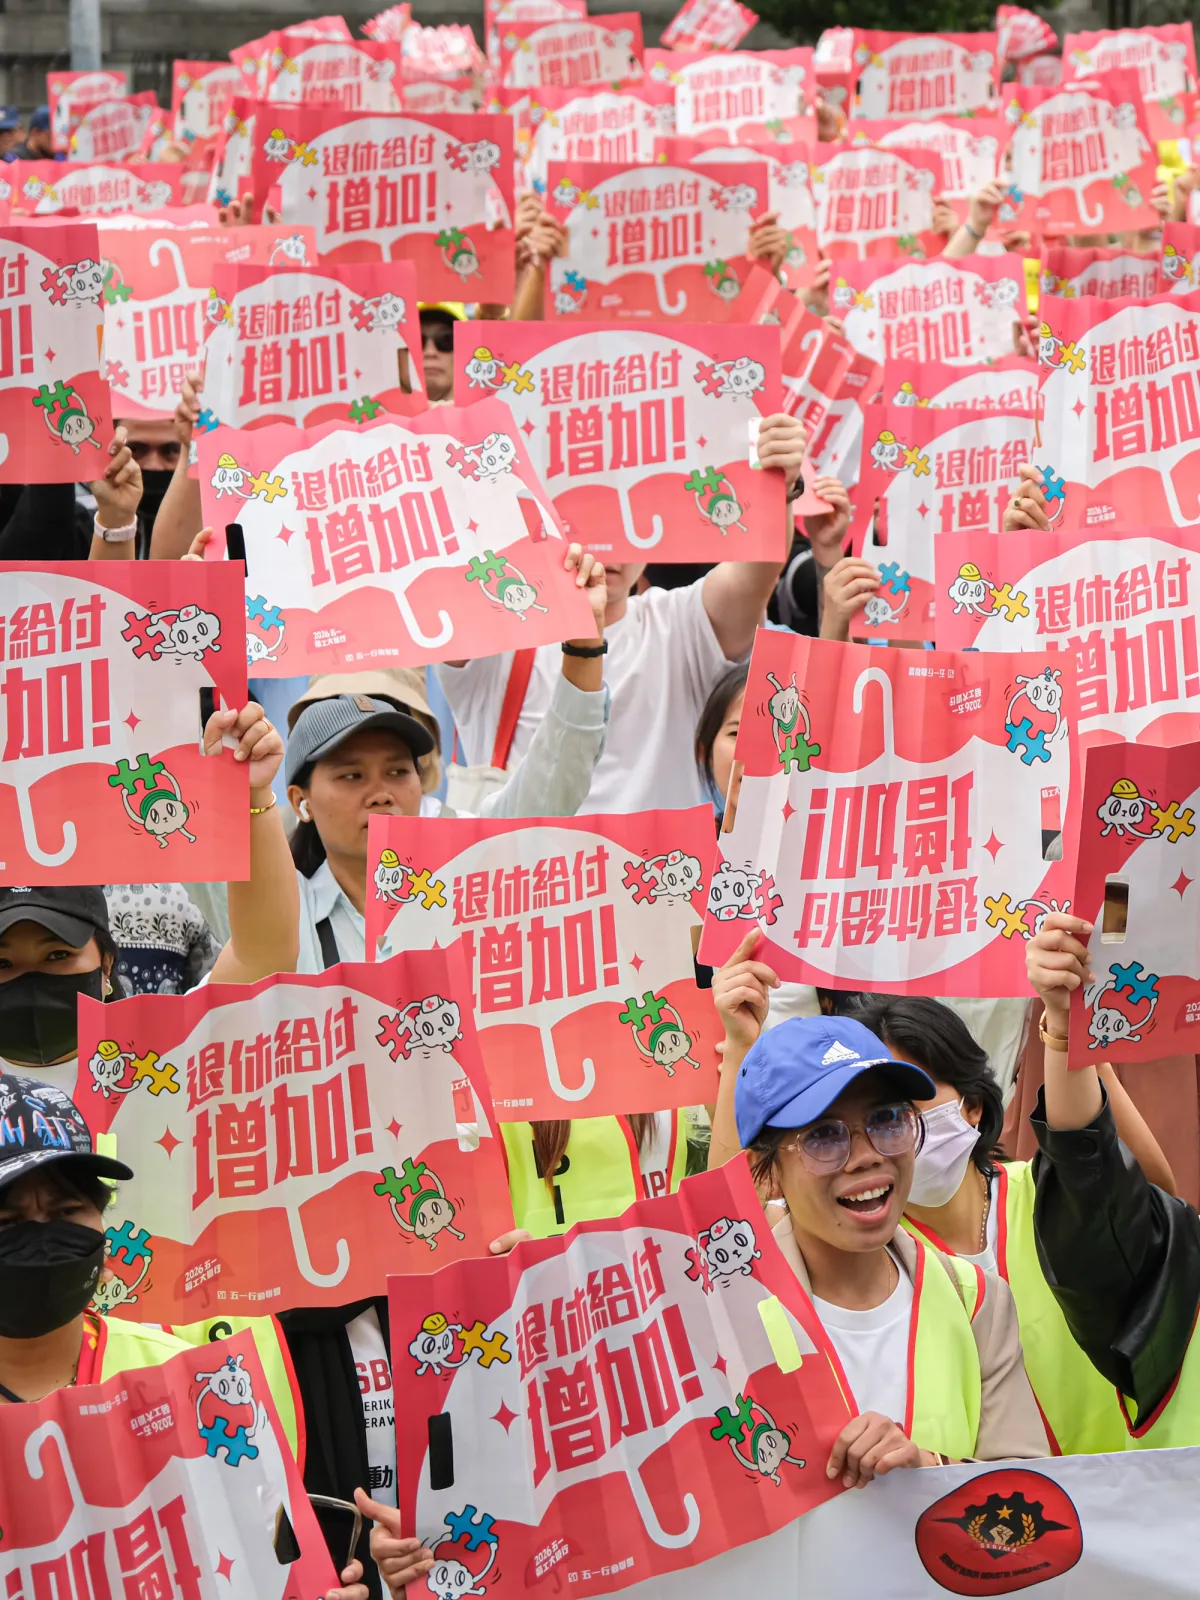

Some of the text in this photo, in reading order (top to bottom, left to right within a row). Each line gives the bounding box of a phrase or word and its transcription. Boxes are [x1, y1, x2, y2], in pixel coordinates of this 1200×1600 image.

[322, 133, 436, 177] 退休給付
[324, 171, 438, 234] 增加!
[604, 180, 702, 218] 退休給付
[606, 211, 704, 268] 增加!
[238, 286, 342, 340] 退休給付
[878, 276, 965, 319] 退休給付
[239, 331, 348, 408] 增加!
[883, 311, 971, 361] 增加!
[1089, 319, 1200, 386] 退休給付
[540, 348, 683, 407] 退休給付
[546, 395, 687, 480] 增加!
[935, 438, 1037, 490] 退休給
[292, 441, 433, 513] 退休給付
[305, 486, 461, 589] 增加!
[0, 593, 106, 661] 給付
[1034, 557, 1192, 638] 退休給付
[800, 770, 975, 881] 增加!
[452, 845, 610, 926] 退休給付
[793, 876, 979, 949] 退休給付
[461, 904, 620, 1014] 增加!
[186, 996, 359, 1112] 退休給付
[821, 1051, 861, 1066] adidas
[192, 1062, 375, 1212] 增加!
[514, 1236, 667, 1383] 退休給付
[364, 1399, 395, 1412] ERIK
[527, 1303, 704, 1489] 增加!
[980, 1542, 1018, 1553] SERIMA
